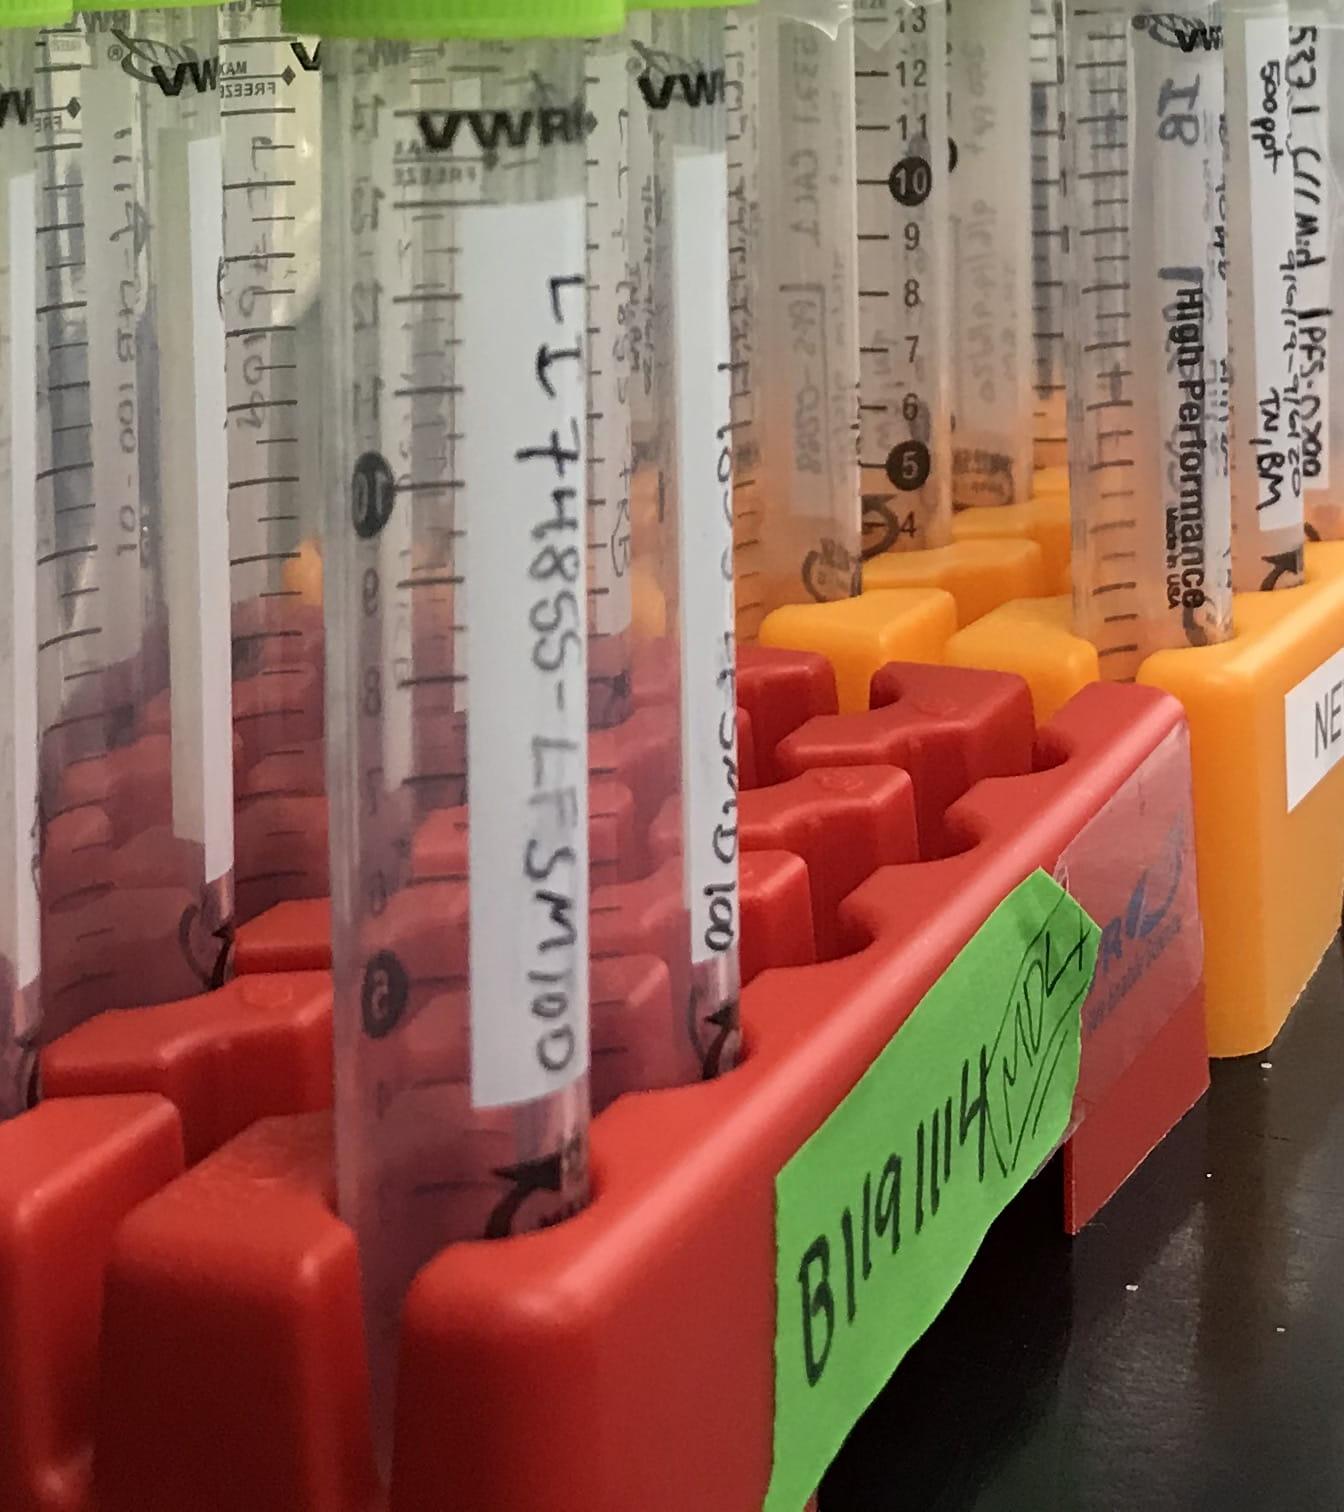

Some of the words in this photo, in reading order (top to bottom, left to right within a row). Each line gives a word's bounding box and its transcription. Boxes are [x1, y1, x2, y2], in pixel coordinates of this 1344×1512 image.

[896, 59, 928, 88] 12
[897, 112, 927, 141] 11
[903, 221, 920, 250] 9
[903, 278, 920, 308] 8
[1167, 286, 1206, 368] High
[903, 334, 920, 363] 7
[901, 392, 919, 421] 6
[1176, 378, 1208, 611] Performance
